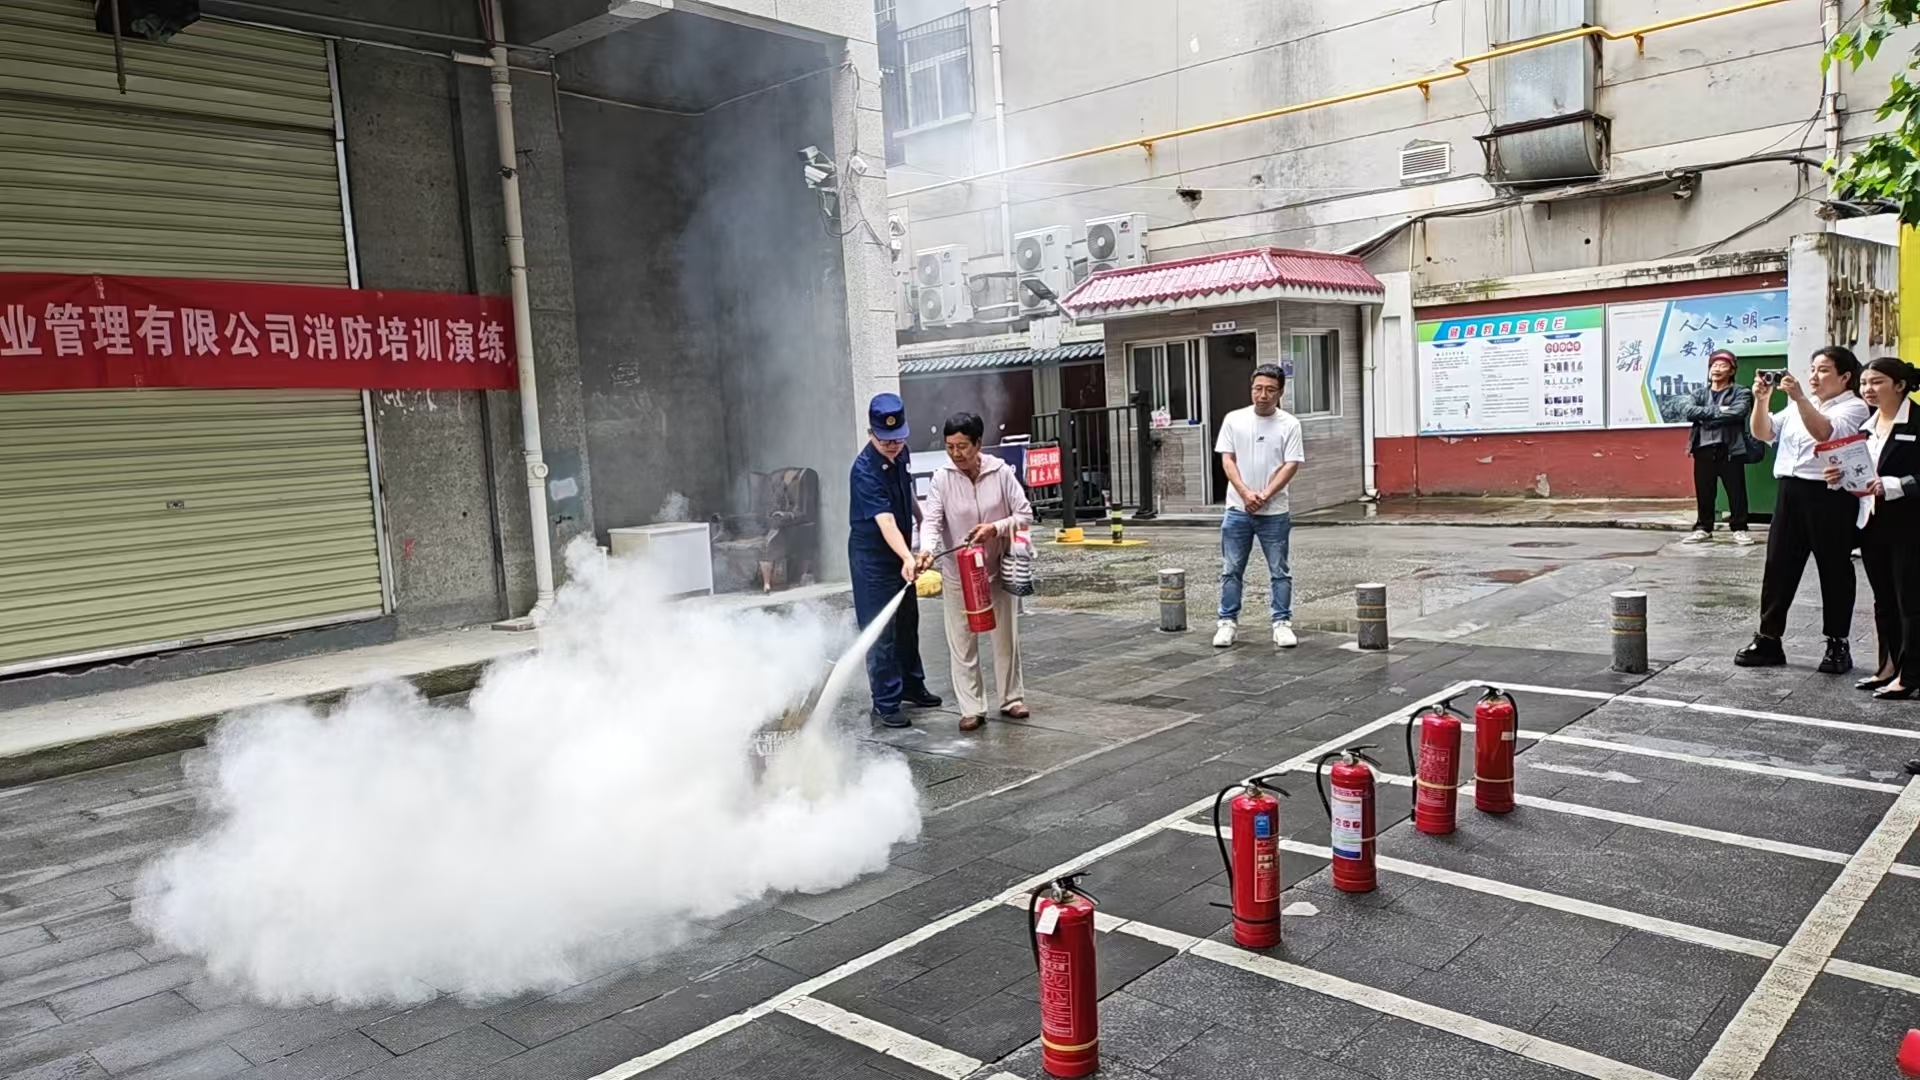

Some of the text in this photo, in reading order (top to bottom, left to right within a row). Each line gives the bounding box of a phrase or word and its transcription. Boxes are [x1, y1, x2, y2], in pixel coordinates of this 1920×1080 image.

[1450, 318, 1565, 338] 健康教育宣传栏
[1679, 311, 1788, 332] 人人文明一
[0, 302, 506, 364] 业管理有限公司消防培训演练
